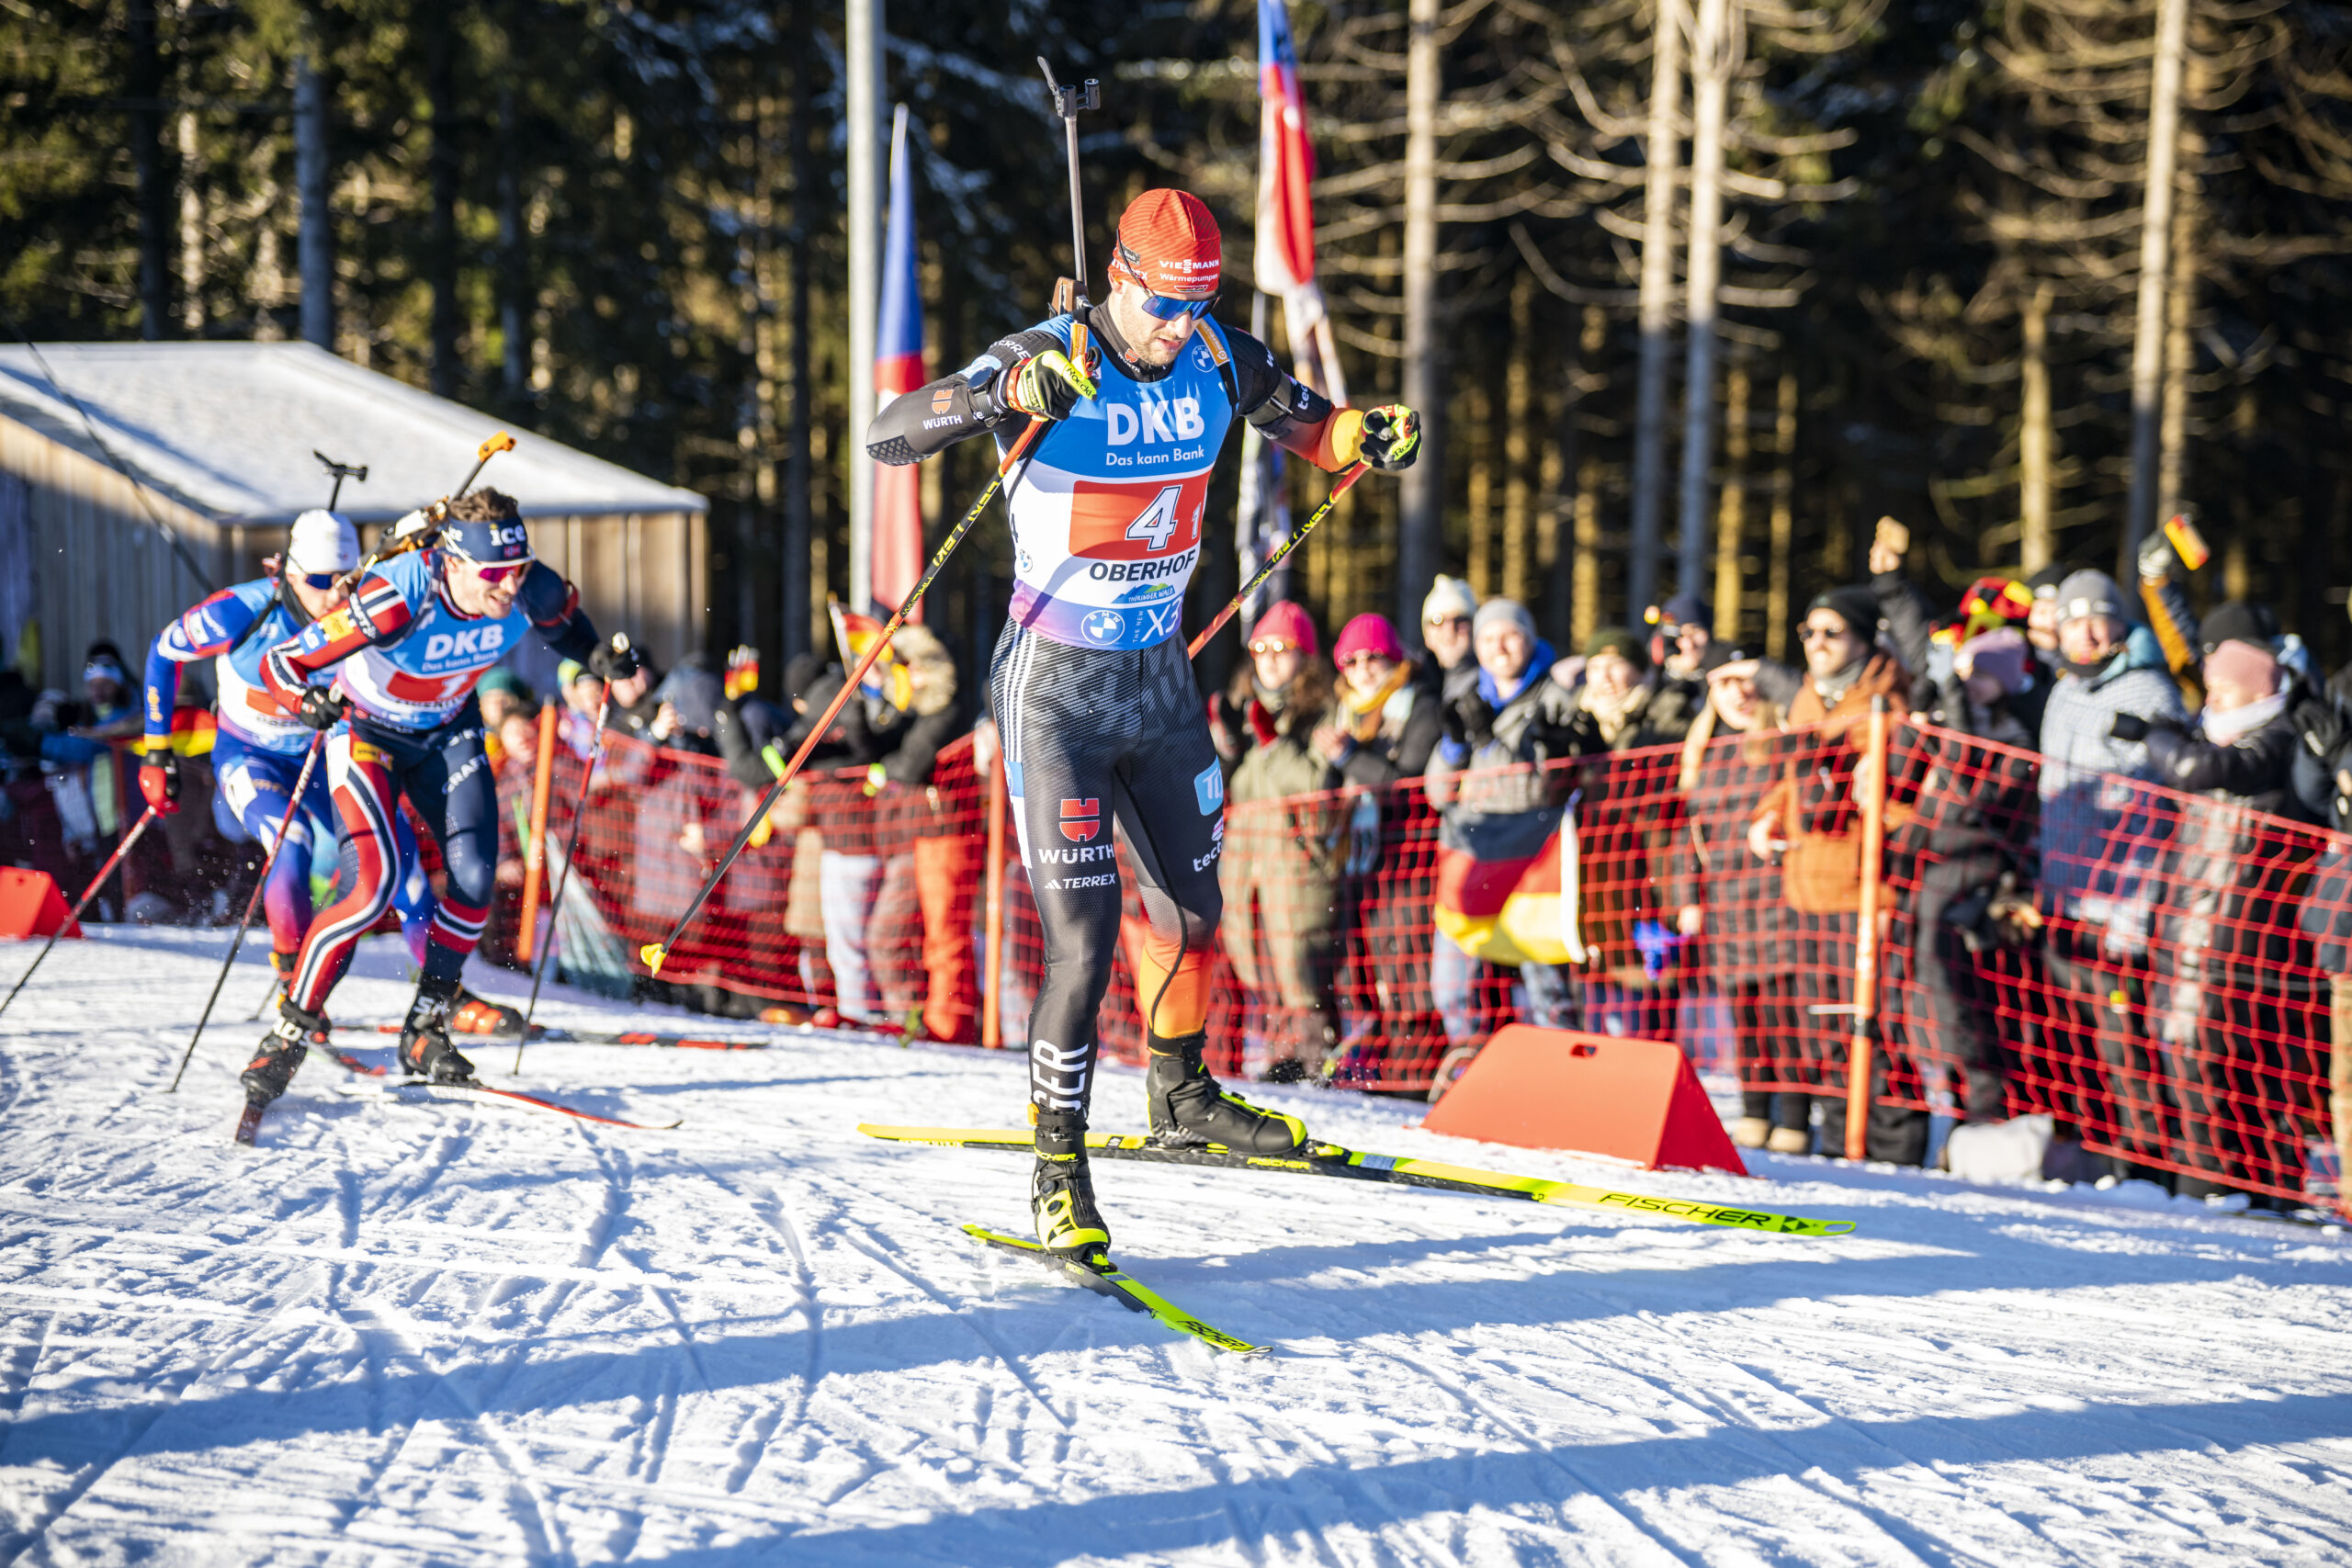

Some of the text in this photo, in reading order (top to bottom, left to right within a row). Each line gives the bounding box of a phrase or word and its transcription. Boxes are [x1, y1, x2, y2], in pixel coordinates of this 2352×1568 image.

[1159, 259, 1219, 274] VIESSMANN
[1159, 274, 1218, 283] Wärmepumpen
[923, 415, 962, 429] WÜRTH
[1106, 397, 1205, 446] DKB
[1106, 445, 1204, 466] Das kann Bank
[1125, 484, 1183, 551] 4
[1192, 502, 1202, 540] 1
[489, 524, 526, 546] ice
[933, 523, 965, 567] LEKI
[1089, 549, 1195, 581] OBERHOF
[1140, 596, 1182, 642] X3
[424, 624, 503, 660] DKB
[1038, 843, 1115, 864] WÜRTH
[1063, 874, 1115, 889] TERREX
[1246, 1156, 1310, 1170] FISCHER
[1599, 1192, 1771, 1227] FISCHER
